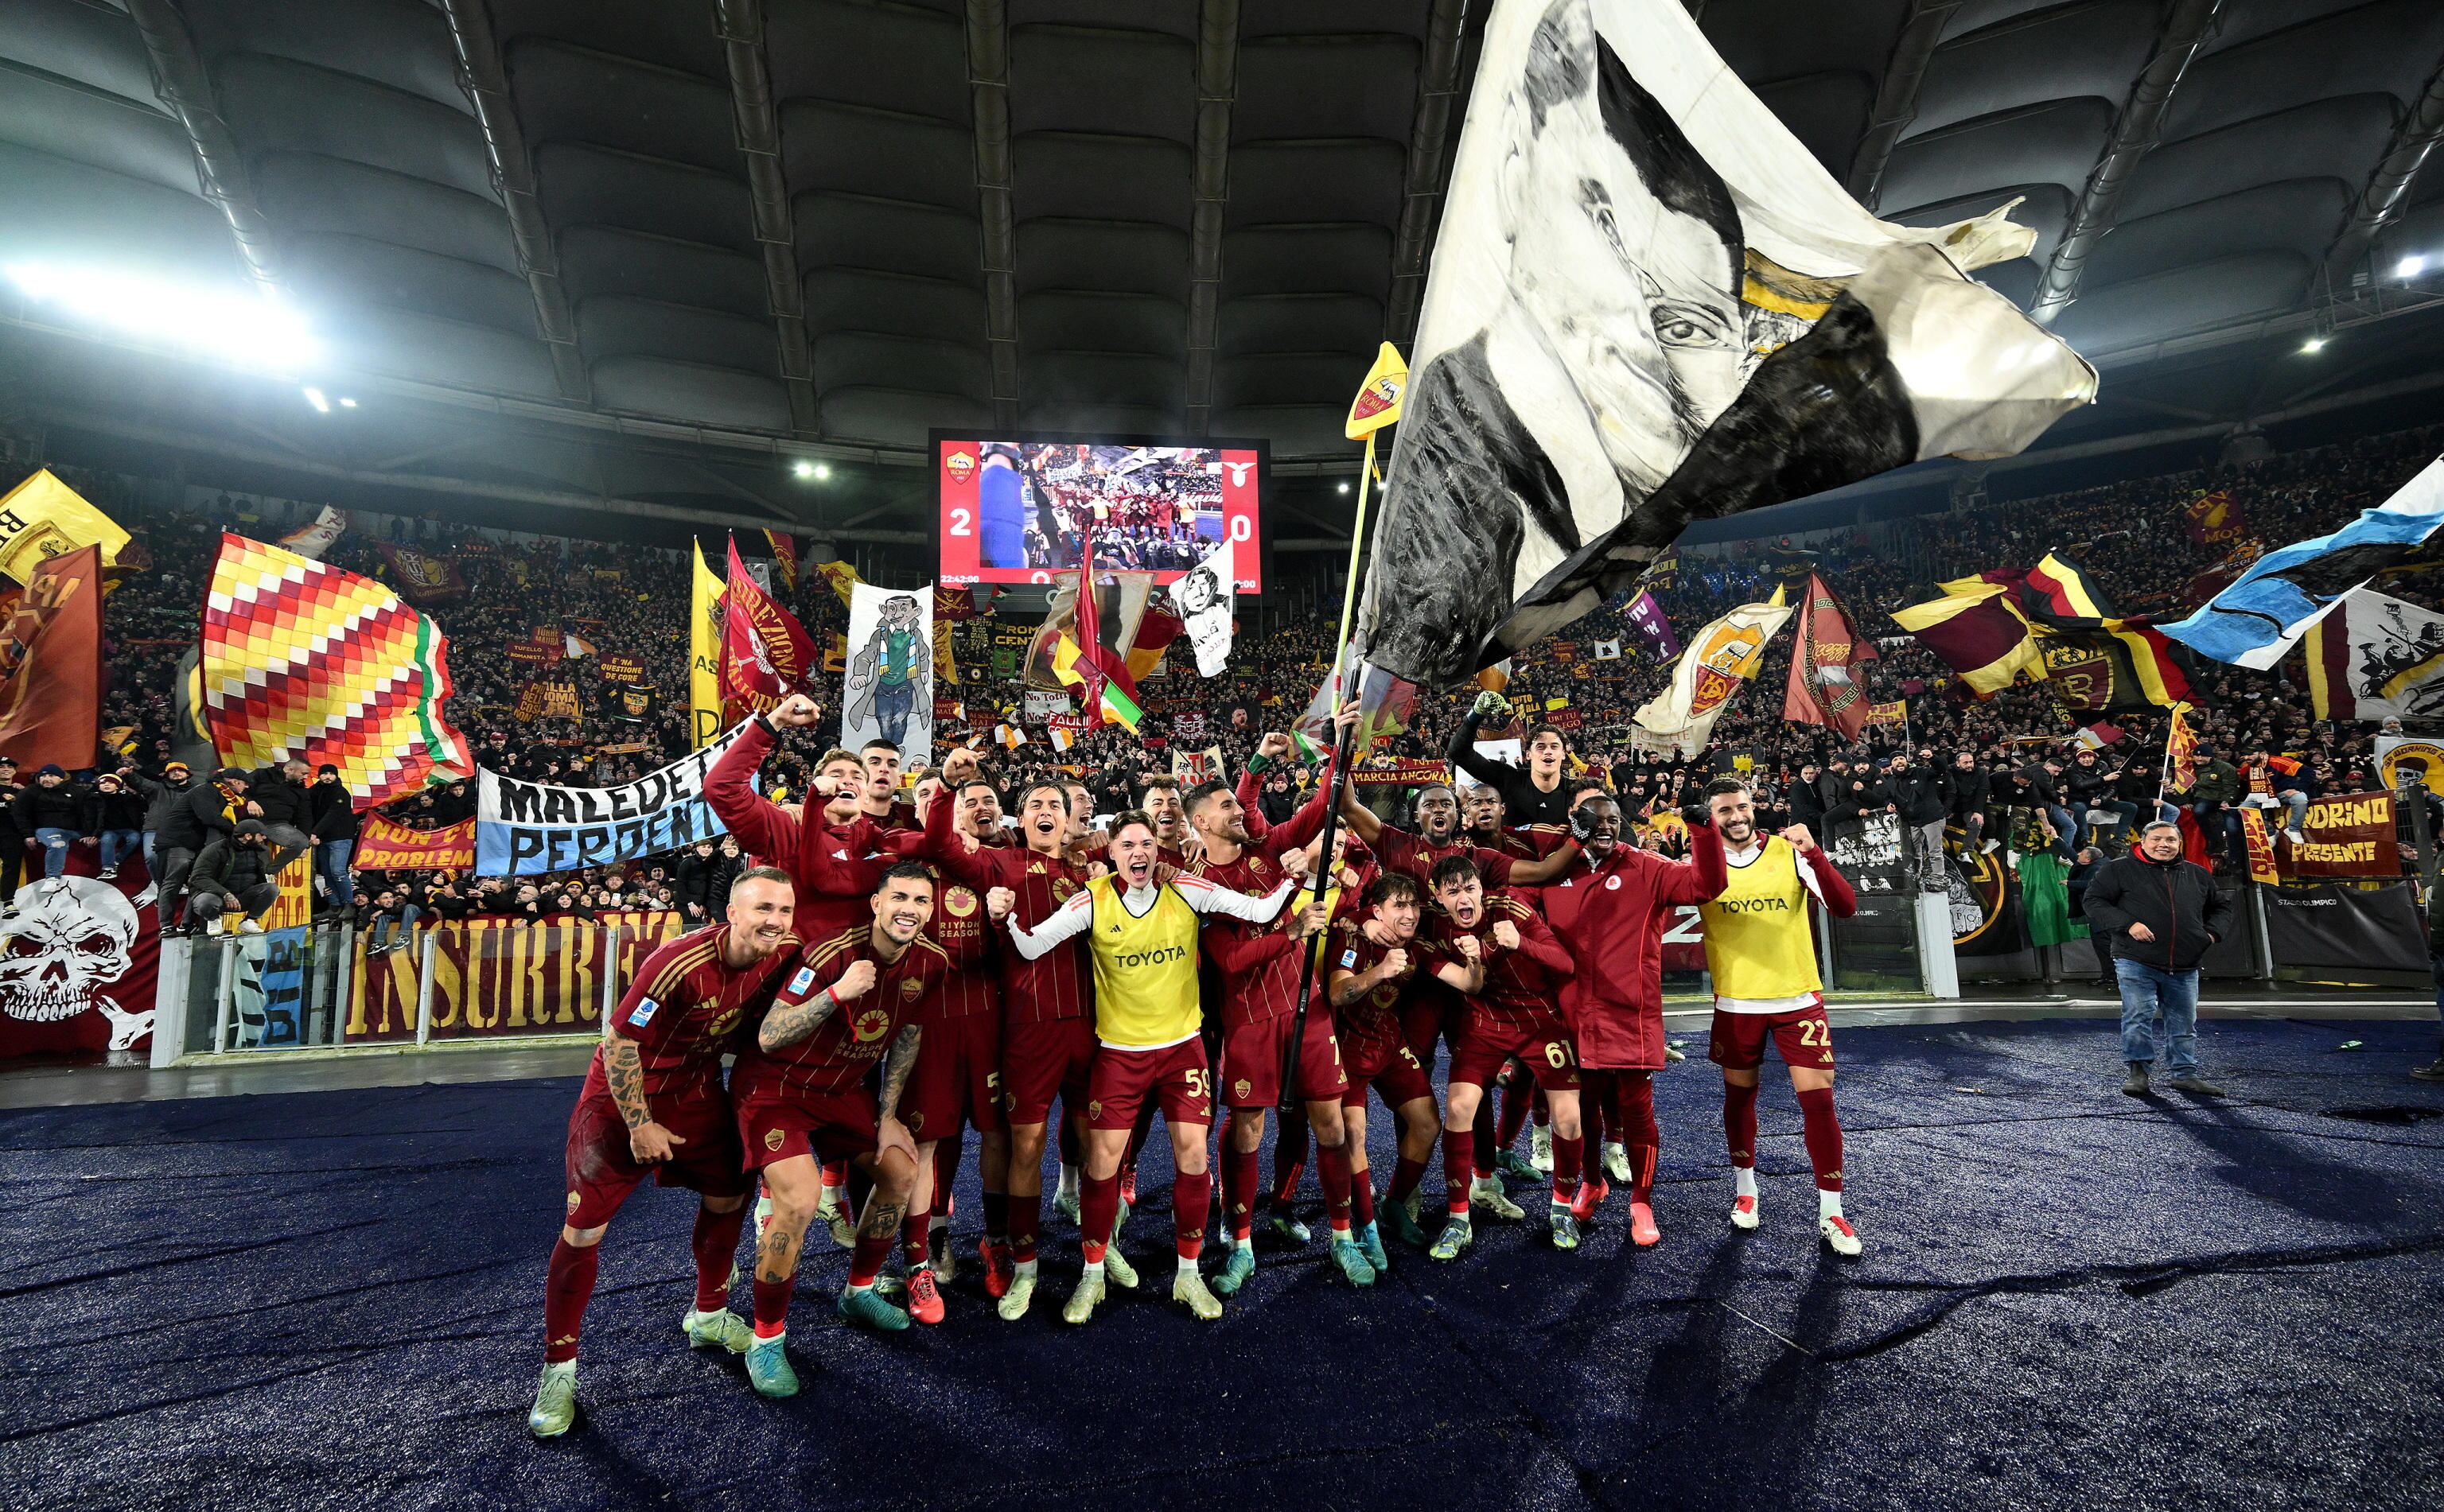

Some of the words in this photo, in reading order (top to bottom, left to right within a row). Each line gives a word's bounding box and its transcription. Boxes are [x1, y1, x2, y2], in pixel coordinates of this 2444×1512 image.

[1360, 395, 1384, 412] ROMA
[950, 508, 971, 536] 2
[1230, 516, 1251, 542] 0
[941, 574, 979, 583] 22:42:00
[510, 652, 546, 661] ROMANISTA
[601, 663, 643, 674] QUESTIONE
[1042, 692, 1068, 701] Totti
[1509, 694, 1533, 705] TUTTO
[1516, 703, 1540, 715] PRLA
[1027, 713, 1040, 722] No
[1179, 721, 1204, 733] ASR
[1354, 772, 1398, 782] MARCIA
[1400, 771, 1445, 782] ANCORA
[364, 819, 432, 845] NUN
[355, 848, 473, 868] PROBLEM
[2291, 841, 2376, 862] PRESENTE
[1718, 897, 1789, 914] TOYOTA
[940, 921, 981, 930] RIYADH
[940, 929, 981, 938] SEASON
[1115, 945, 1185, 968] TOYOTA
[1797, 1019, 1832, 1047] 22
[835, 1048, 881, 1059] SEASON
[839, 1042, 885, 1053] RIYADH
[1329, 1035, 1340, 1066] 7
[1545, 1039, 1576, 1069] 61
[987, 1071, 1000, 1103] 5
[1185, 1068, 1210, 1098] 59
